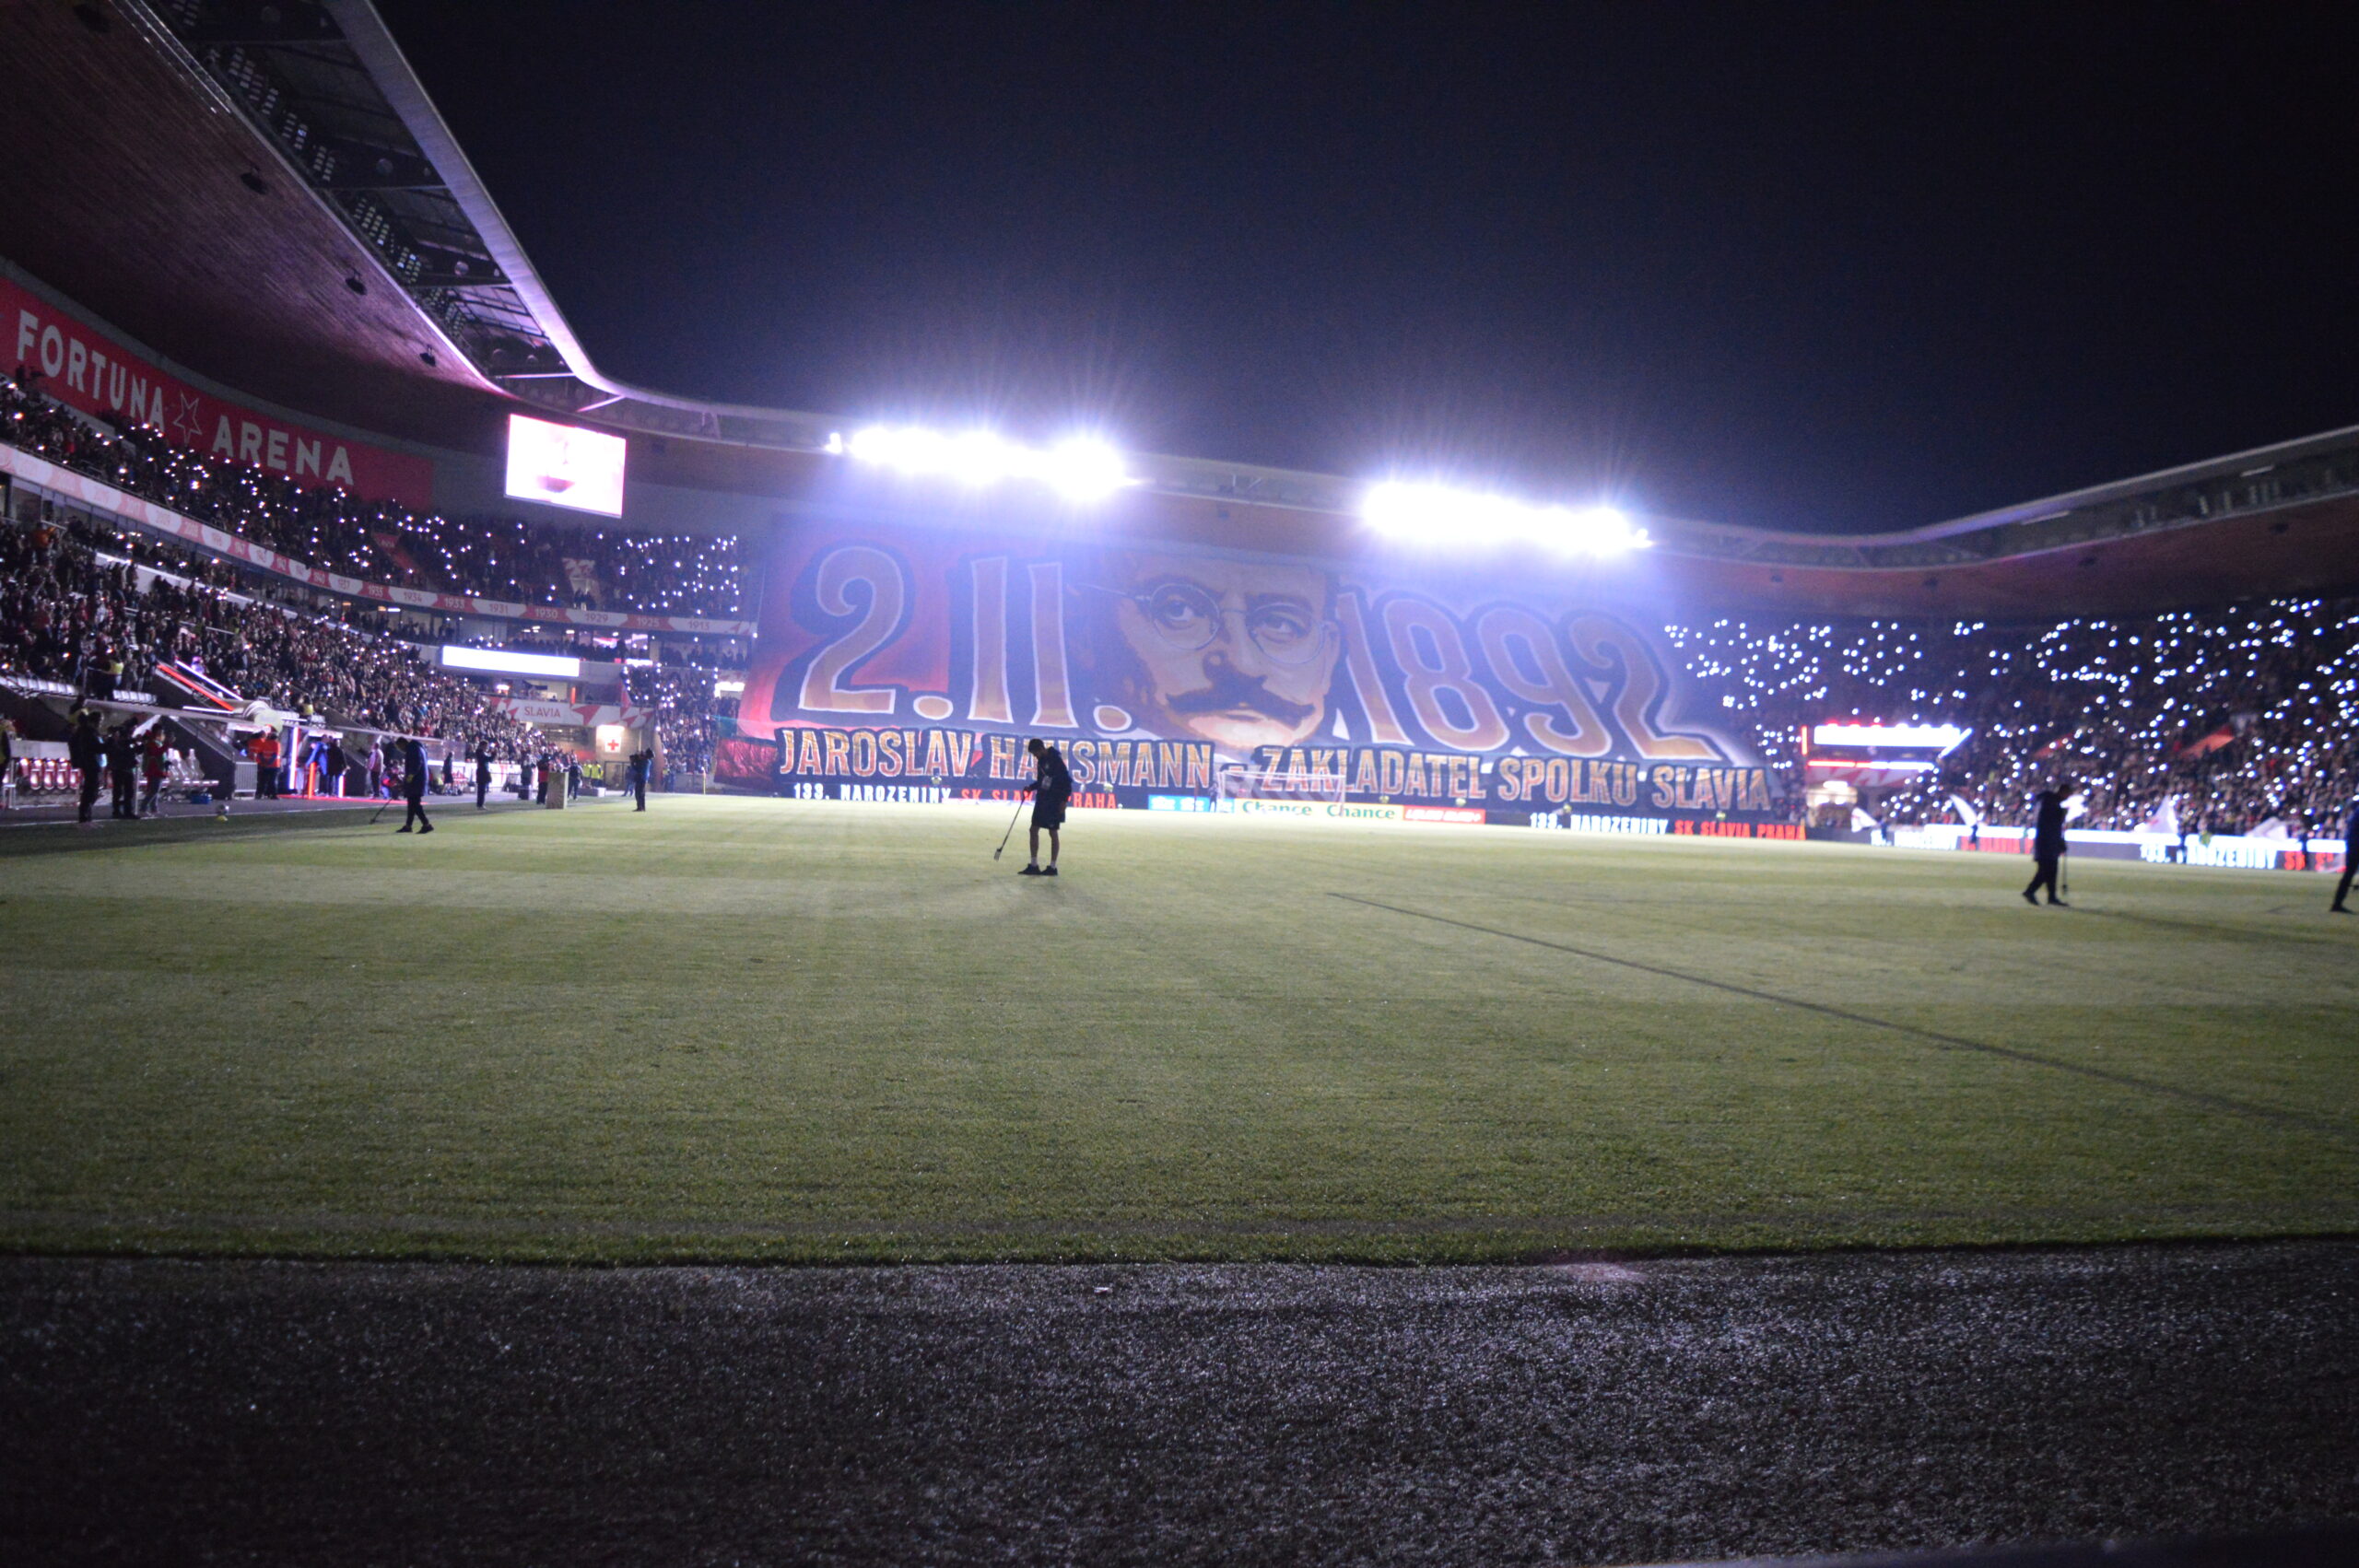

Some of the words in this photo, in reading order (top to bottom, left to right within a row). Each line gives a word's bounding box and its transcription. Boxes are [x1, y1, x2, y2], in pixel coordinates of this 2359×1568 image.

[17, 309, 164, 432] FORTUNA
[212, 415, 354, 486] ARENA
[404, 591, 422, 603] 1934
[445, 598, 465, 609] 1933
[489, 604, 509, 615] 1931
[534, 609, 558, 620] 1930
[584, 614, 609, 624] 1929
[637, 616, 660, 628] 1925
[1335, 592, 1723, 761] 1892
[523, 706, 561, 719] SLAVIA
[780, 729, 972, 778] JAROSLAV
[1260, 747, 1487, 799] ZAKLADATEL
[1497, 756, 1638, 807] SPOLKU
[1651, 765, 1772, 811] SLAVIA
[793, 782, 830, 801] 133.
[840, 784, 952, 803] NAROZENINY
[1067, 792, 1117, 810] RAHA
[1327, 803, 1396, 820] Chance
[1530, 813, 1563, 830] 133.
[1570, 814, 1669, 836] NAROZENINY
[1674, 820, 1694, 837] SK
[1701, 822, 1750, 839] SLAVIA
[1756, 825, 1807, 841] PRAHA
